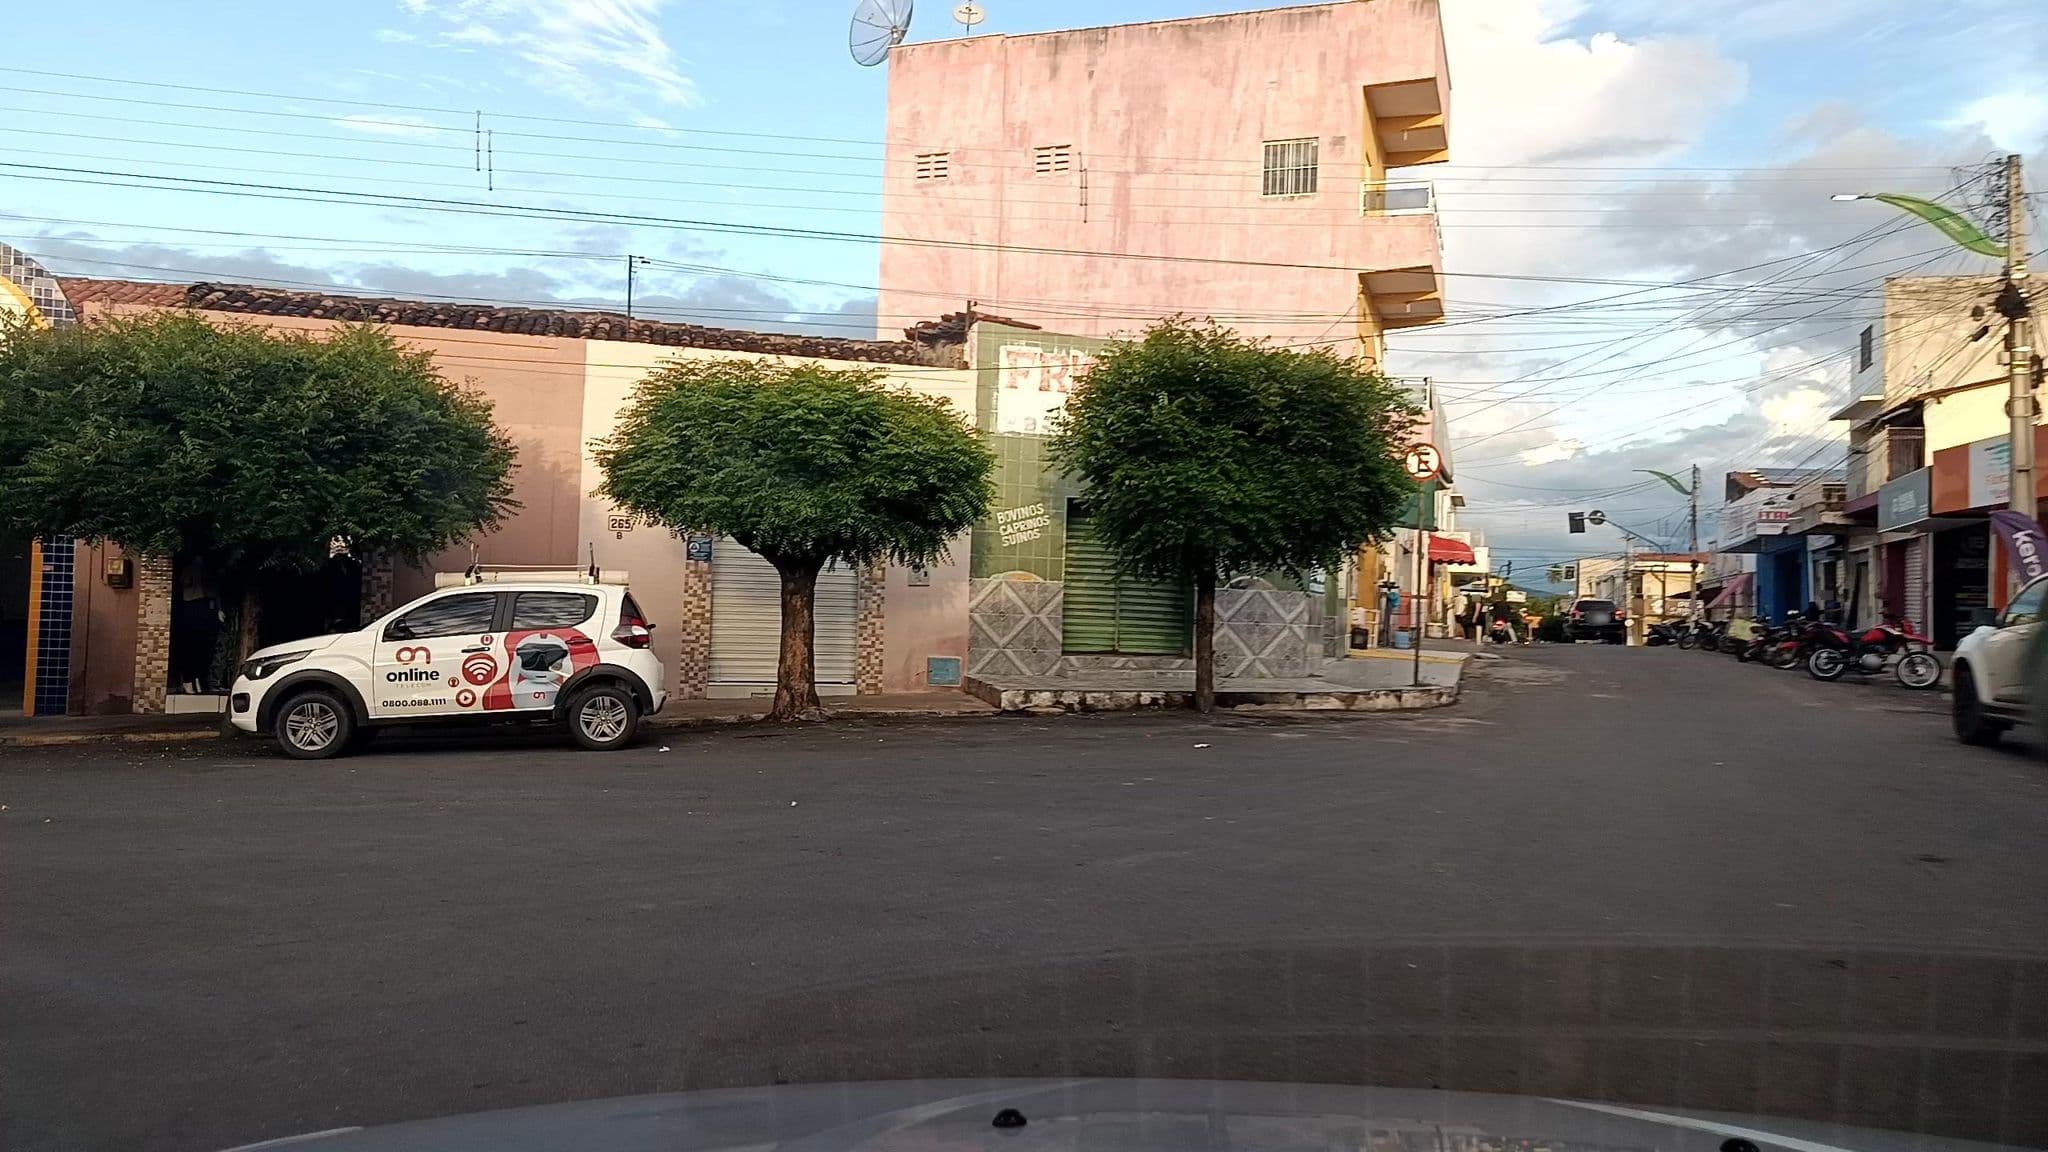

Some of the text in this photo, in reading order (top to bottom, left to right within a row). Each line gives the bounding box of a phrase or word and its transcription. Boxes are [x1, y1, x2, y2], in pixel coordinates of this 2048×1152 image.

[997, 503, 1044, 524] BOVINOS
[610, 518, 631, 529] 265
[1000, 515, 1050, 536] CAPRINOS
[616, 532, 623, 540] B
[1002, 529, 1041, 547] SUINOS
[386, 668, 440, 683] online
